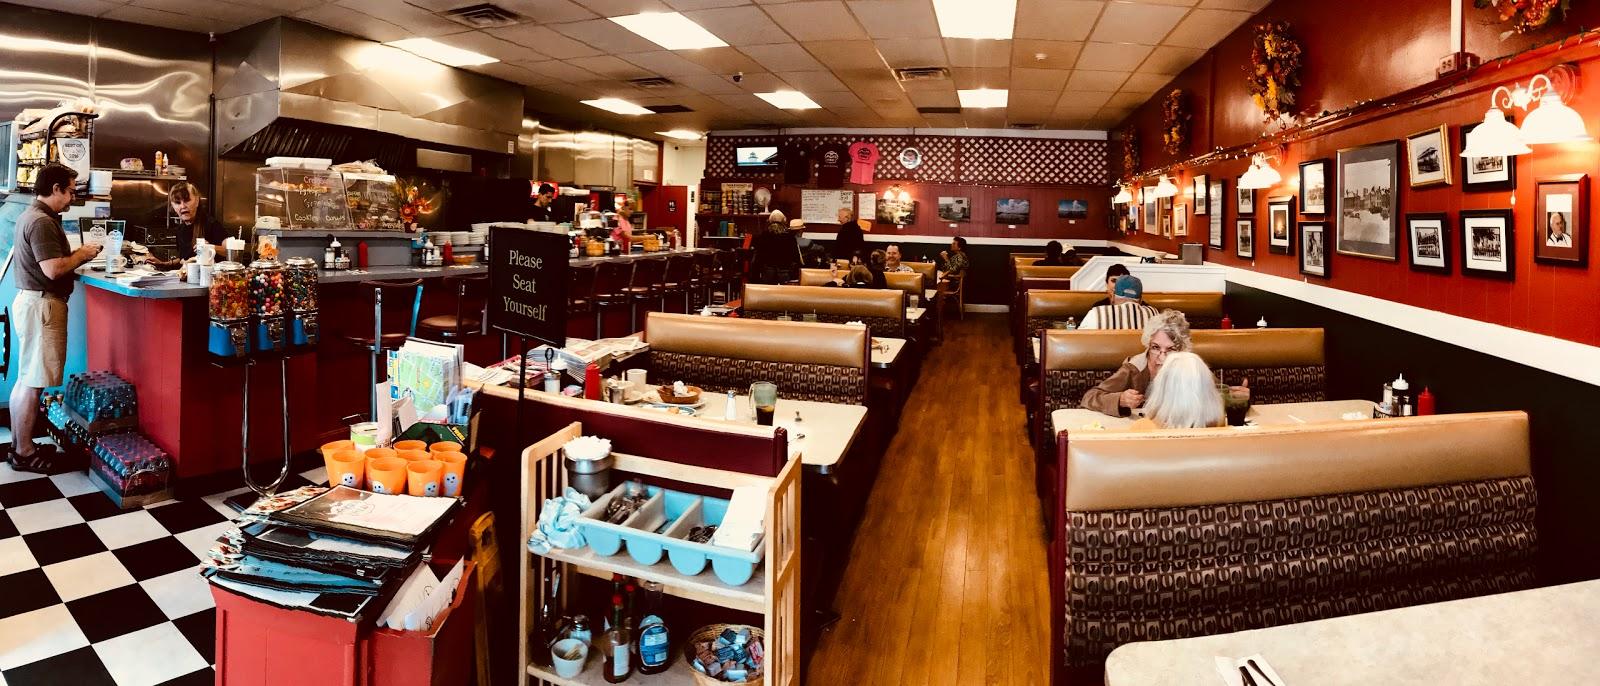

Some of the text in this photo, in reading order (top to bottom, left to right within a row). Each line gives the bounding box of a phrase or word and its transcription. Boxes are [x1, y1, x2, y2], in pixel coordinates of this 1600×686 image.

[508, 249, 543, 270] Please
[512, 273, 537, 294] Seat
[503, 295, 548, 322] Yourself
